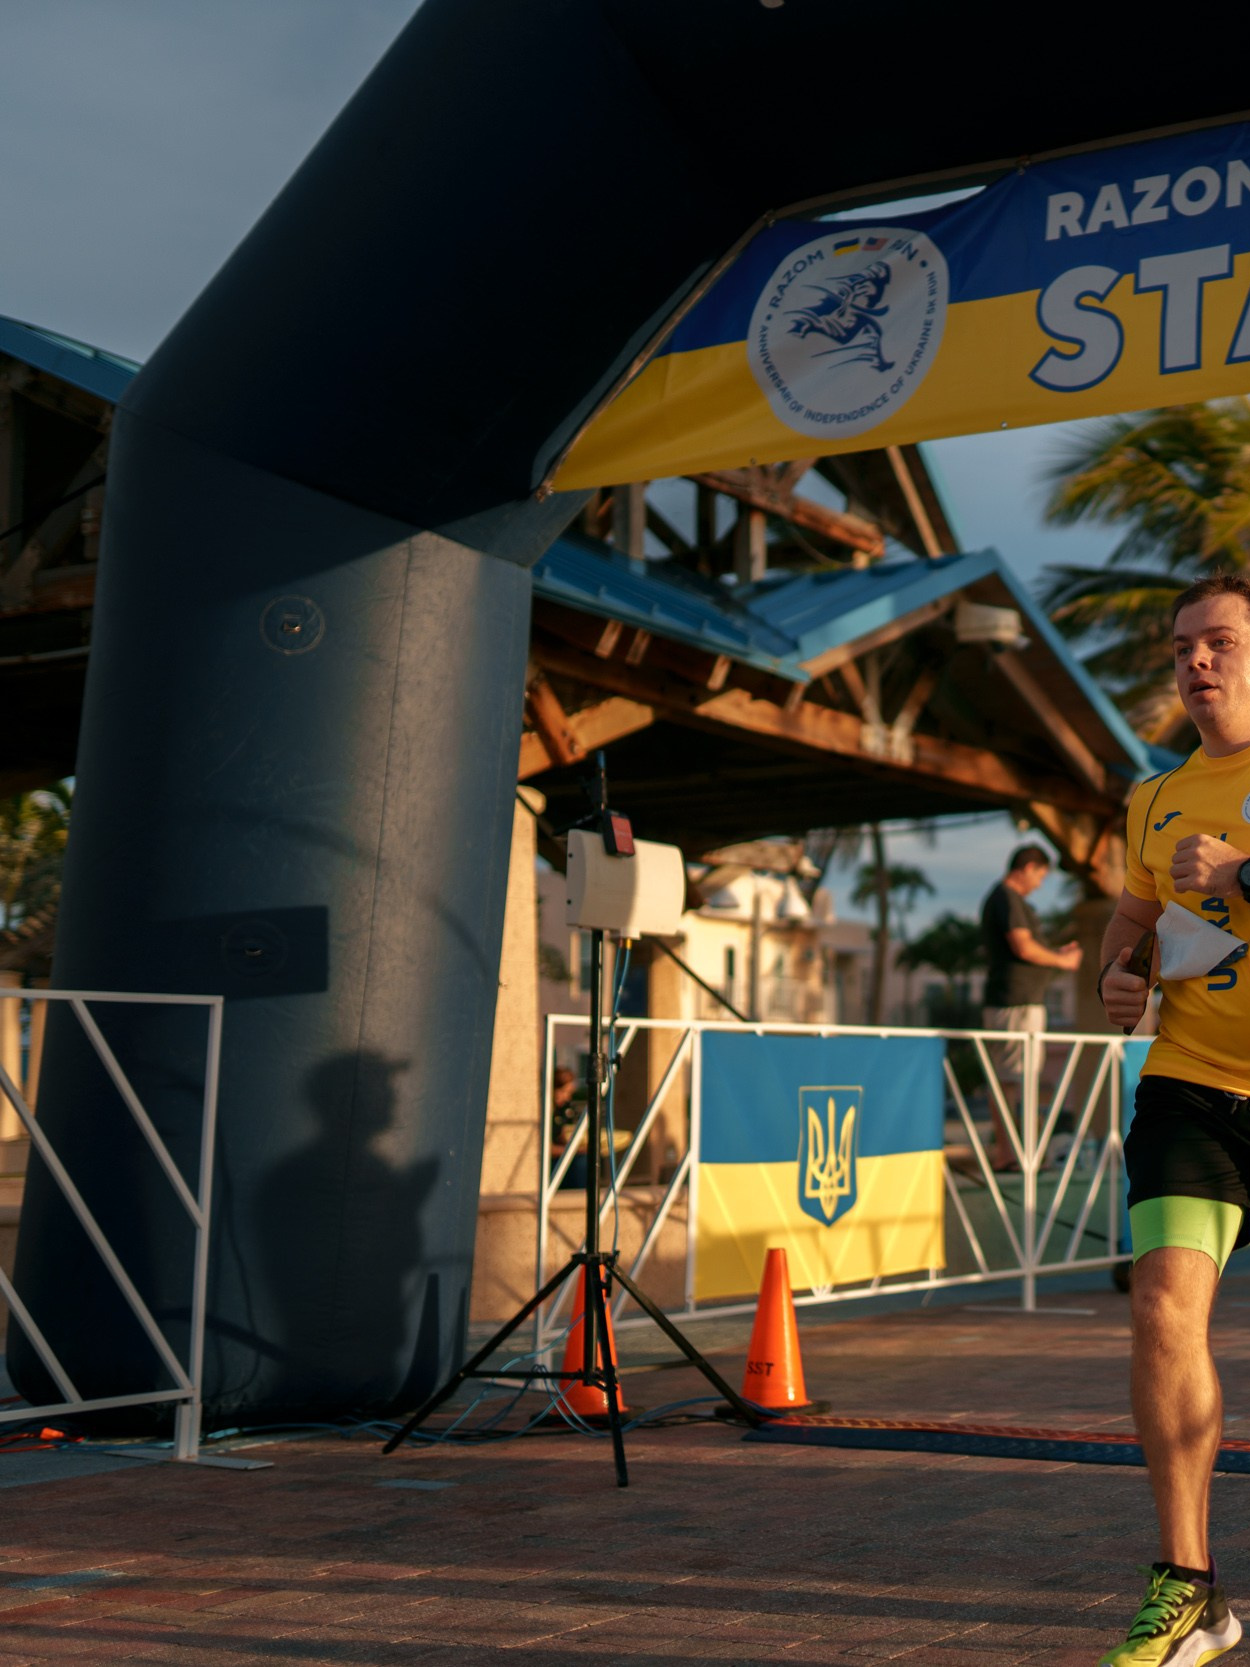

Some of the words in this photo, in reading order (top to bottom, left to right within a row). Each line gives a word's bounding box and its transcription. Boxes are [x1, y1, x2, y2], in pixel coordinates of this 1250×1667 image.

[768, 249, 826, 309] RAZOM
[926, 271, 938, 296] RUN
[926, 297, 937, 315] 5K
[904, 318, 934, 376] UKRAINE
[889, 376, 905, 395] OF
[789, 400, 806, 414] OF
[803, 392, 890, 424] INDEPENDENCE
[747, 1361, 774, 1376] SST
